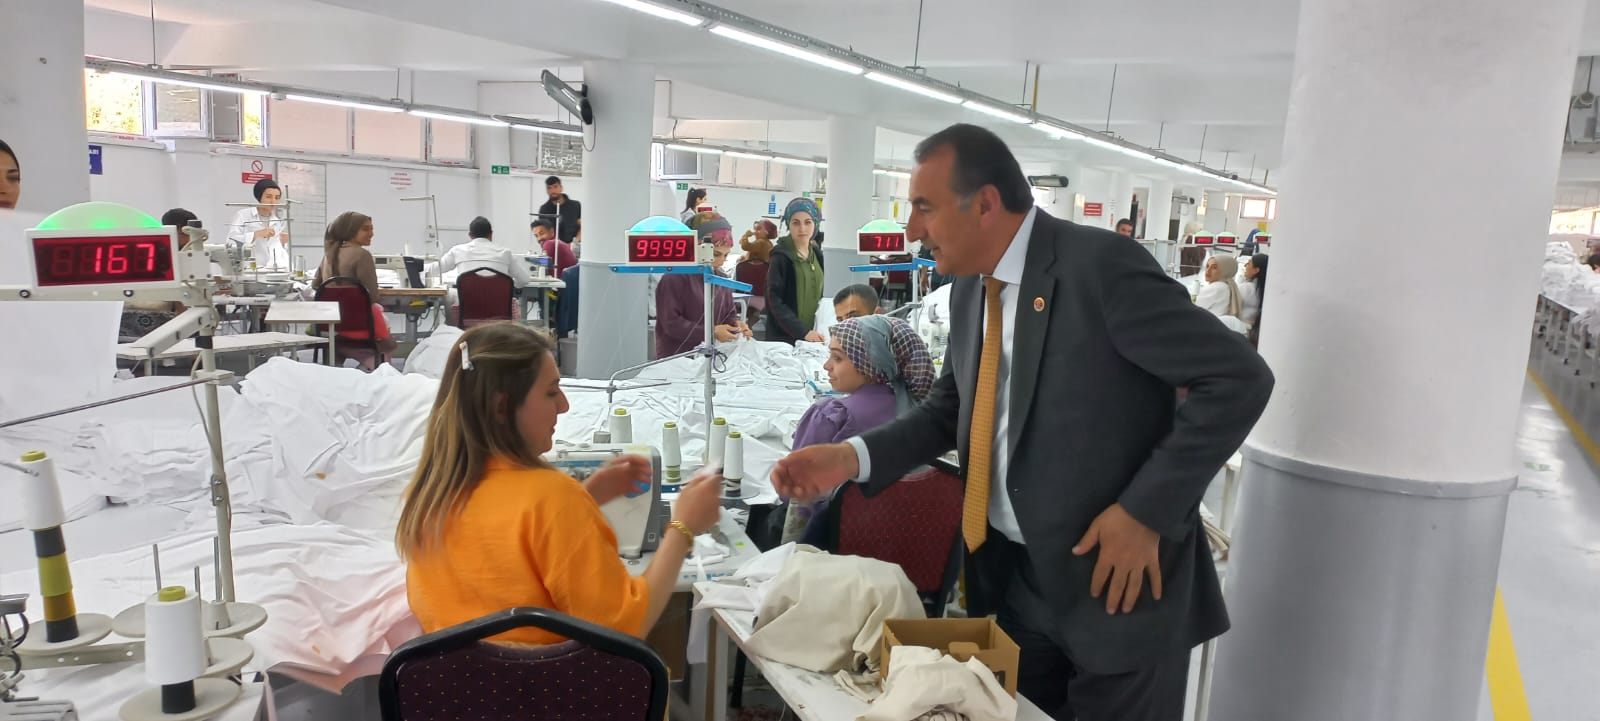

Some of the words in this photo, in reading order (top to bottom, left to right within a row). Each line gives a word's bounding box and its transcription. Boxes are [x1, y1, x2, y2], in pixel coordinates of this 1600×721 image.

[636, 239, 687, 257] 9999
[874, 235, 899, 248] 711
[94, 243, 155, 273] 167
